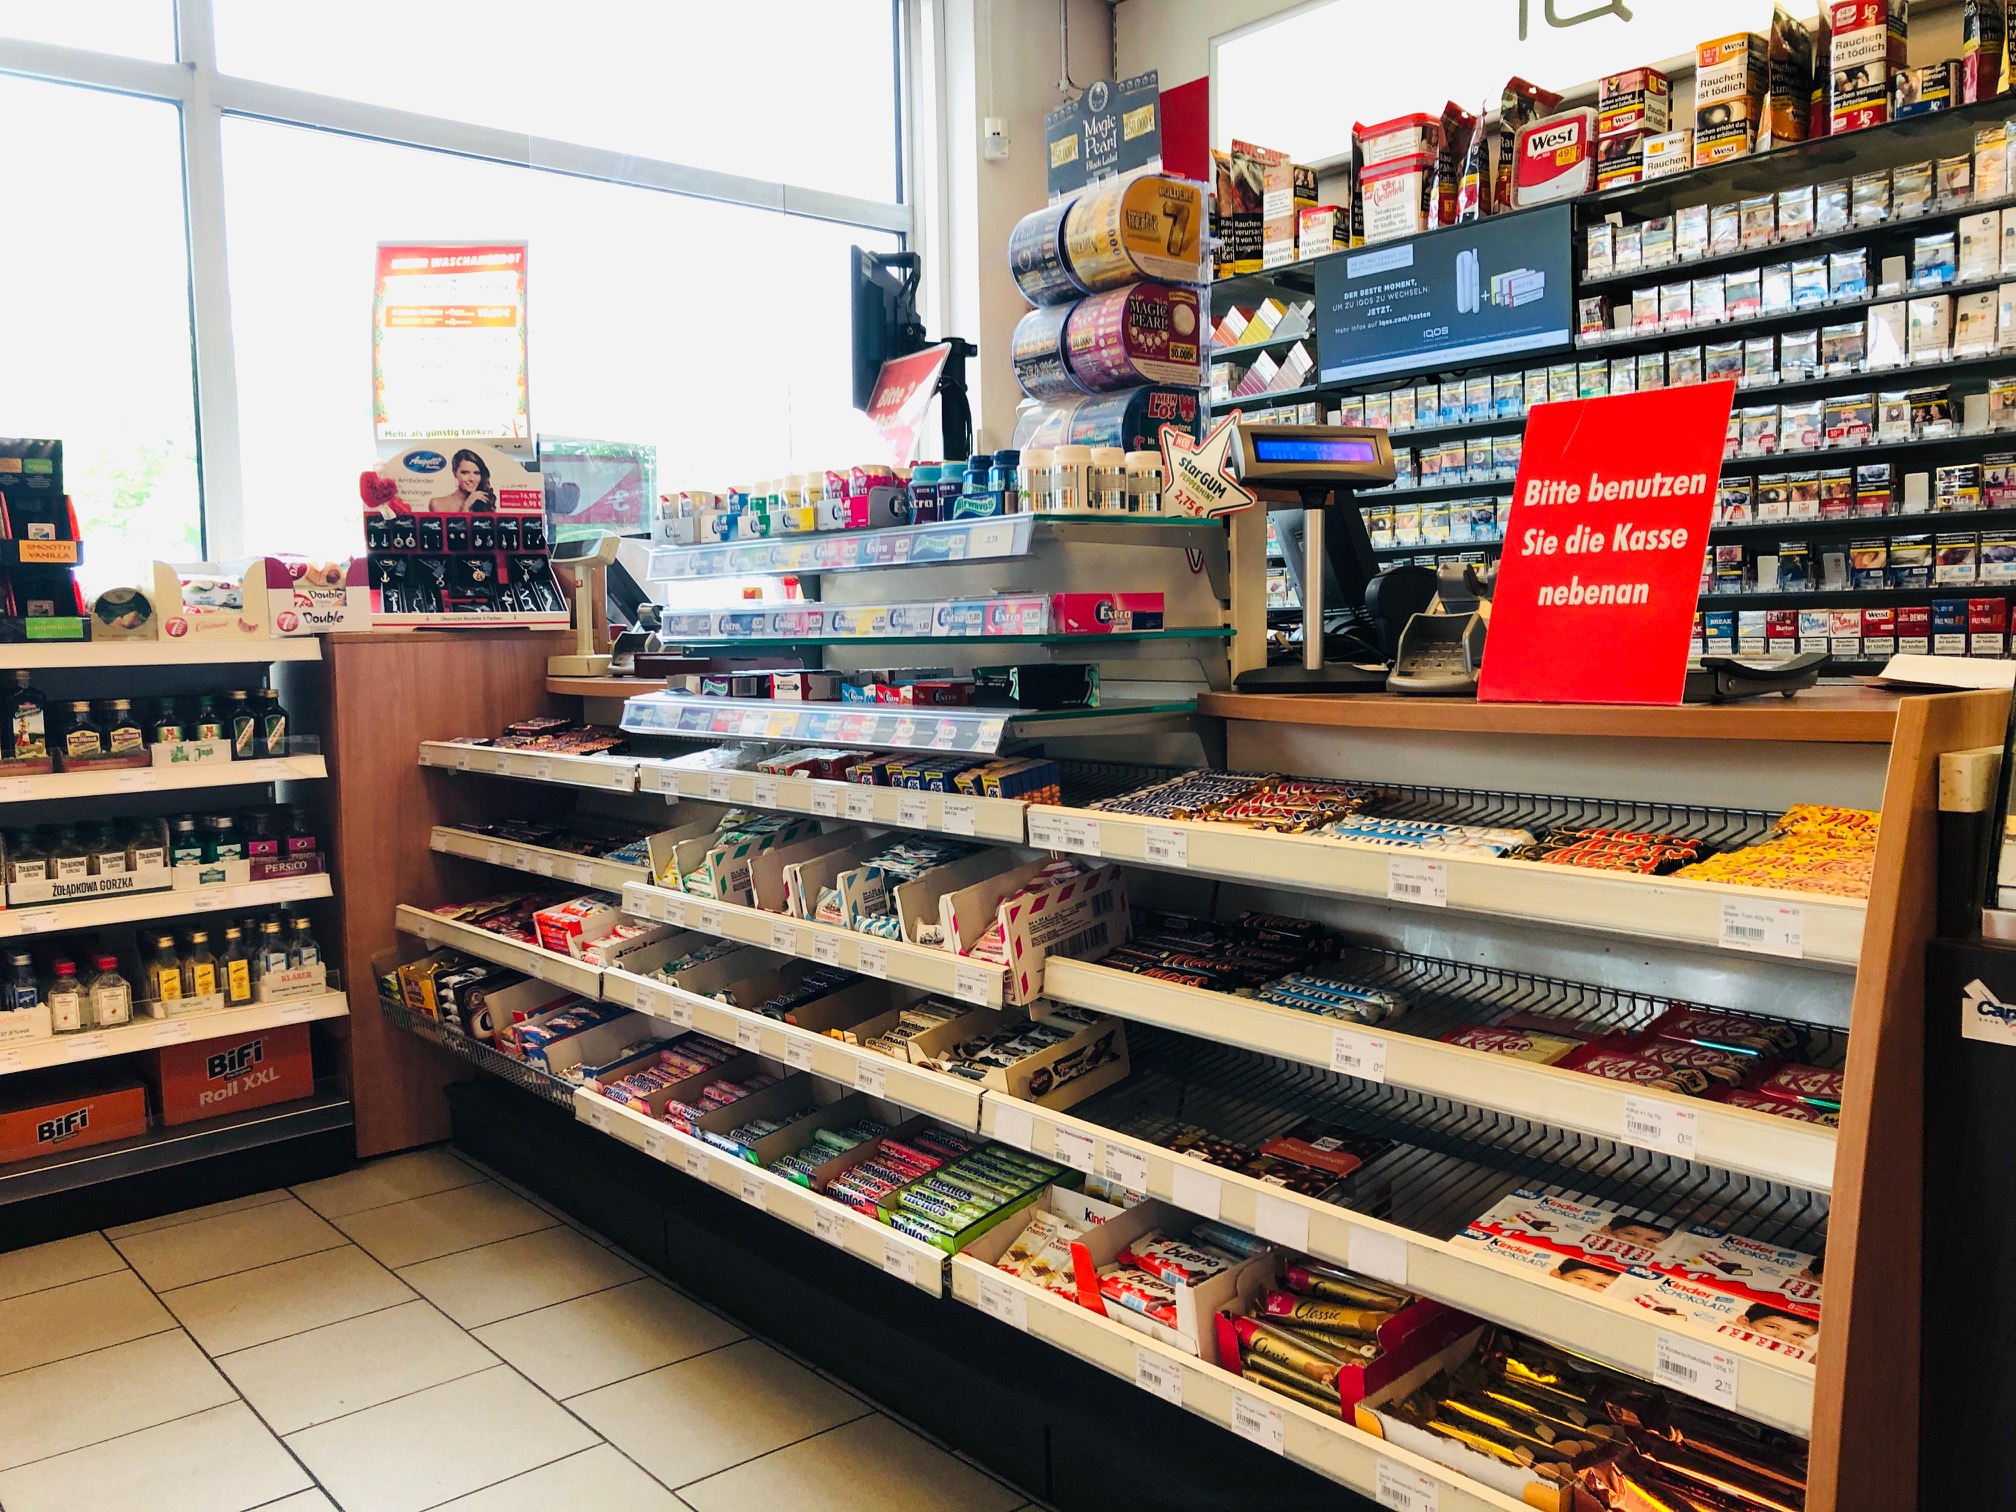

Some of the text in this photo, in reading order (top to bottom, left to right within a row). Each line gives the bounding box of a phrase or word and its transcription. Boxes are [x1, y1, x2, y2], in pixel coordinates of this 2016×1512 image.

[1724, 41, 1745, 51] West
[1836, 32, 1882, 50] Rauchen
[1848, 42, 1885, 58] tödlich
[1700, 72, 1742, 88] Rauchen
[1712, 80, 1745, 96] tödlich
[1083, 115, 1116, 138] Magic
[1085, 130, 1118, 158] Pearl
[1532, 128, 1574, 152] West
[1669, 136, 1686, 146] West
[1714, 146, 1734, 156] West
[1648, 156, 1686, 170] Rauchen
[1373, 180, 1405, 206] Chesterfield
[1375, 204, 1406, 214] Tabakrauch
[1163, 202, 1190, 256] 7
[1344, 278, 1418, 300] DER BESTE MOMENT,
[1130, 302, 1168, 318] MAGIC
[1345, 302, 1354, 310] ZU
[1356, 297, 1374, 306] IQOS
[1367, 305, 1392, 316] JETZT.
[1132, 314, 1168, 330] PEARL
[1379, 312, 1431, 327] iqos.com/testen
[1423, 326, 1448, 338] IQOS
[1148, 392, 1177, 419] LOS
[1156, 394, 1178, 404] MEIN
[426, 427, 459, 440] günstig
[1176, 436, 1190, 450] NEU
[1178, 457, 1228, 500] starGUM
[1180, 472, 1216, 503] PEPPERMINT
[1524, 472, 1707, 506] Bitte benutzen
[1174, 490, 1196, 511] 2,75
[1522, 522, 1688, 556] Sie die Kasse
[308, 590, 344, 600] Double
[1538, 576, 1650, 606] nebenan
[302, 611, 344, 626] Double
[1868, 610, 1888, 618] West
[1910, 613, 1928, 622] DENIM
[264, 860, 308, 874] PERSICO
[52, 877, 134, 898] ŻOŁĄDKOWA GORZKA
[1301, 975, 1381, 996] BOUNTY
[207, 1040, 262, 1079] BiFi
[1585, 1056, 1664, 1080] KitKat
[200, 1066, 280, 1106] Roll XXL
[604, 1086, 630, 1104] mentos
[37, 1108, 88, 1143] BiFi
[826, 1186, 866, 1208] mentos
[929, 1178, 974, 1201] mentos
[903, 1192, 948, 1218] mentos
[1541, 1197, 1582, 1214] Kinder
[1534, 1204, 1602, 1225] SCHOKOLADE
[1026, 1226, 1049, 1240] Country
[1490, 1238, 1533, 1255] Kinder
[1724, 1236, 1778, 1254] Kinder
[1163, 1245, 1220, 1268] bueno
[1482, 1244, 1551, 1269] SCHOKOLADE
[1718, 1242, 1800, 1269] SCHOKOLADE
[1662, 1278, 1715, 1300] Kinder
[1655, 1284, 1737, 1315] SCHOKOLADE
[1294, 1302, 1342, 1320] Classic
[1252, 1337, 1290, 1366] Classic
[1714, 1378, 1723, 1392] 2
